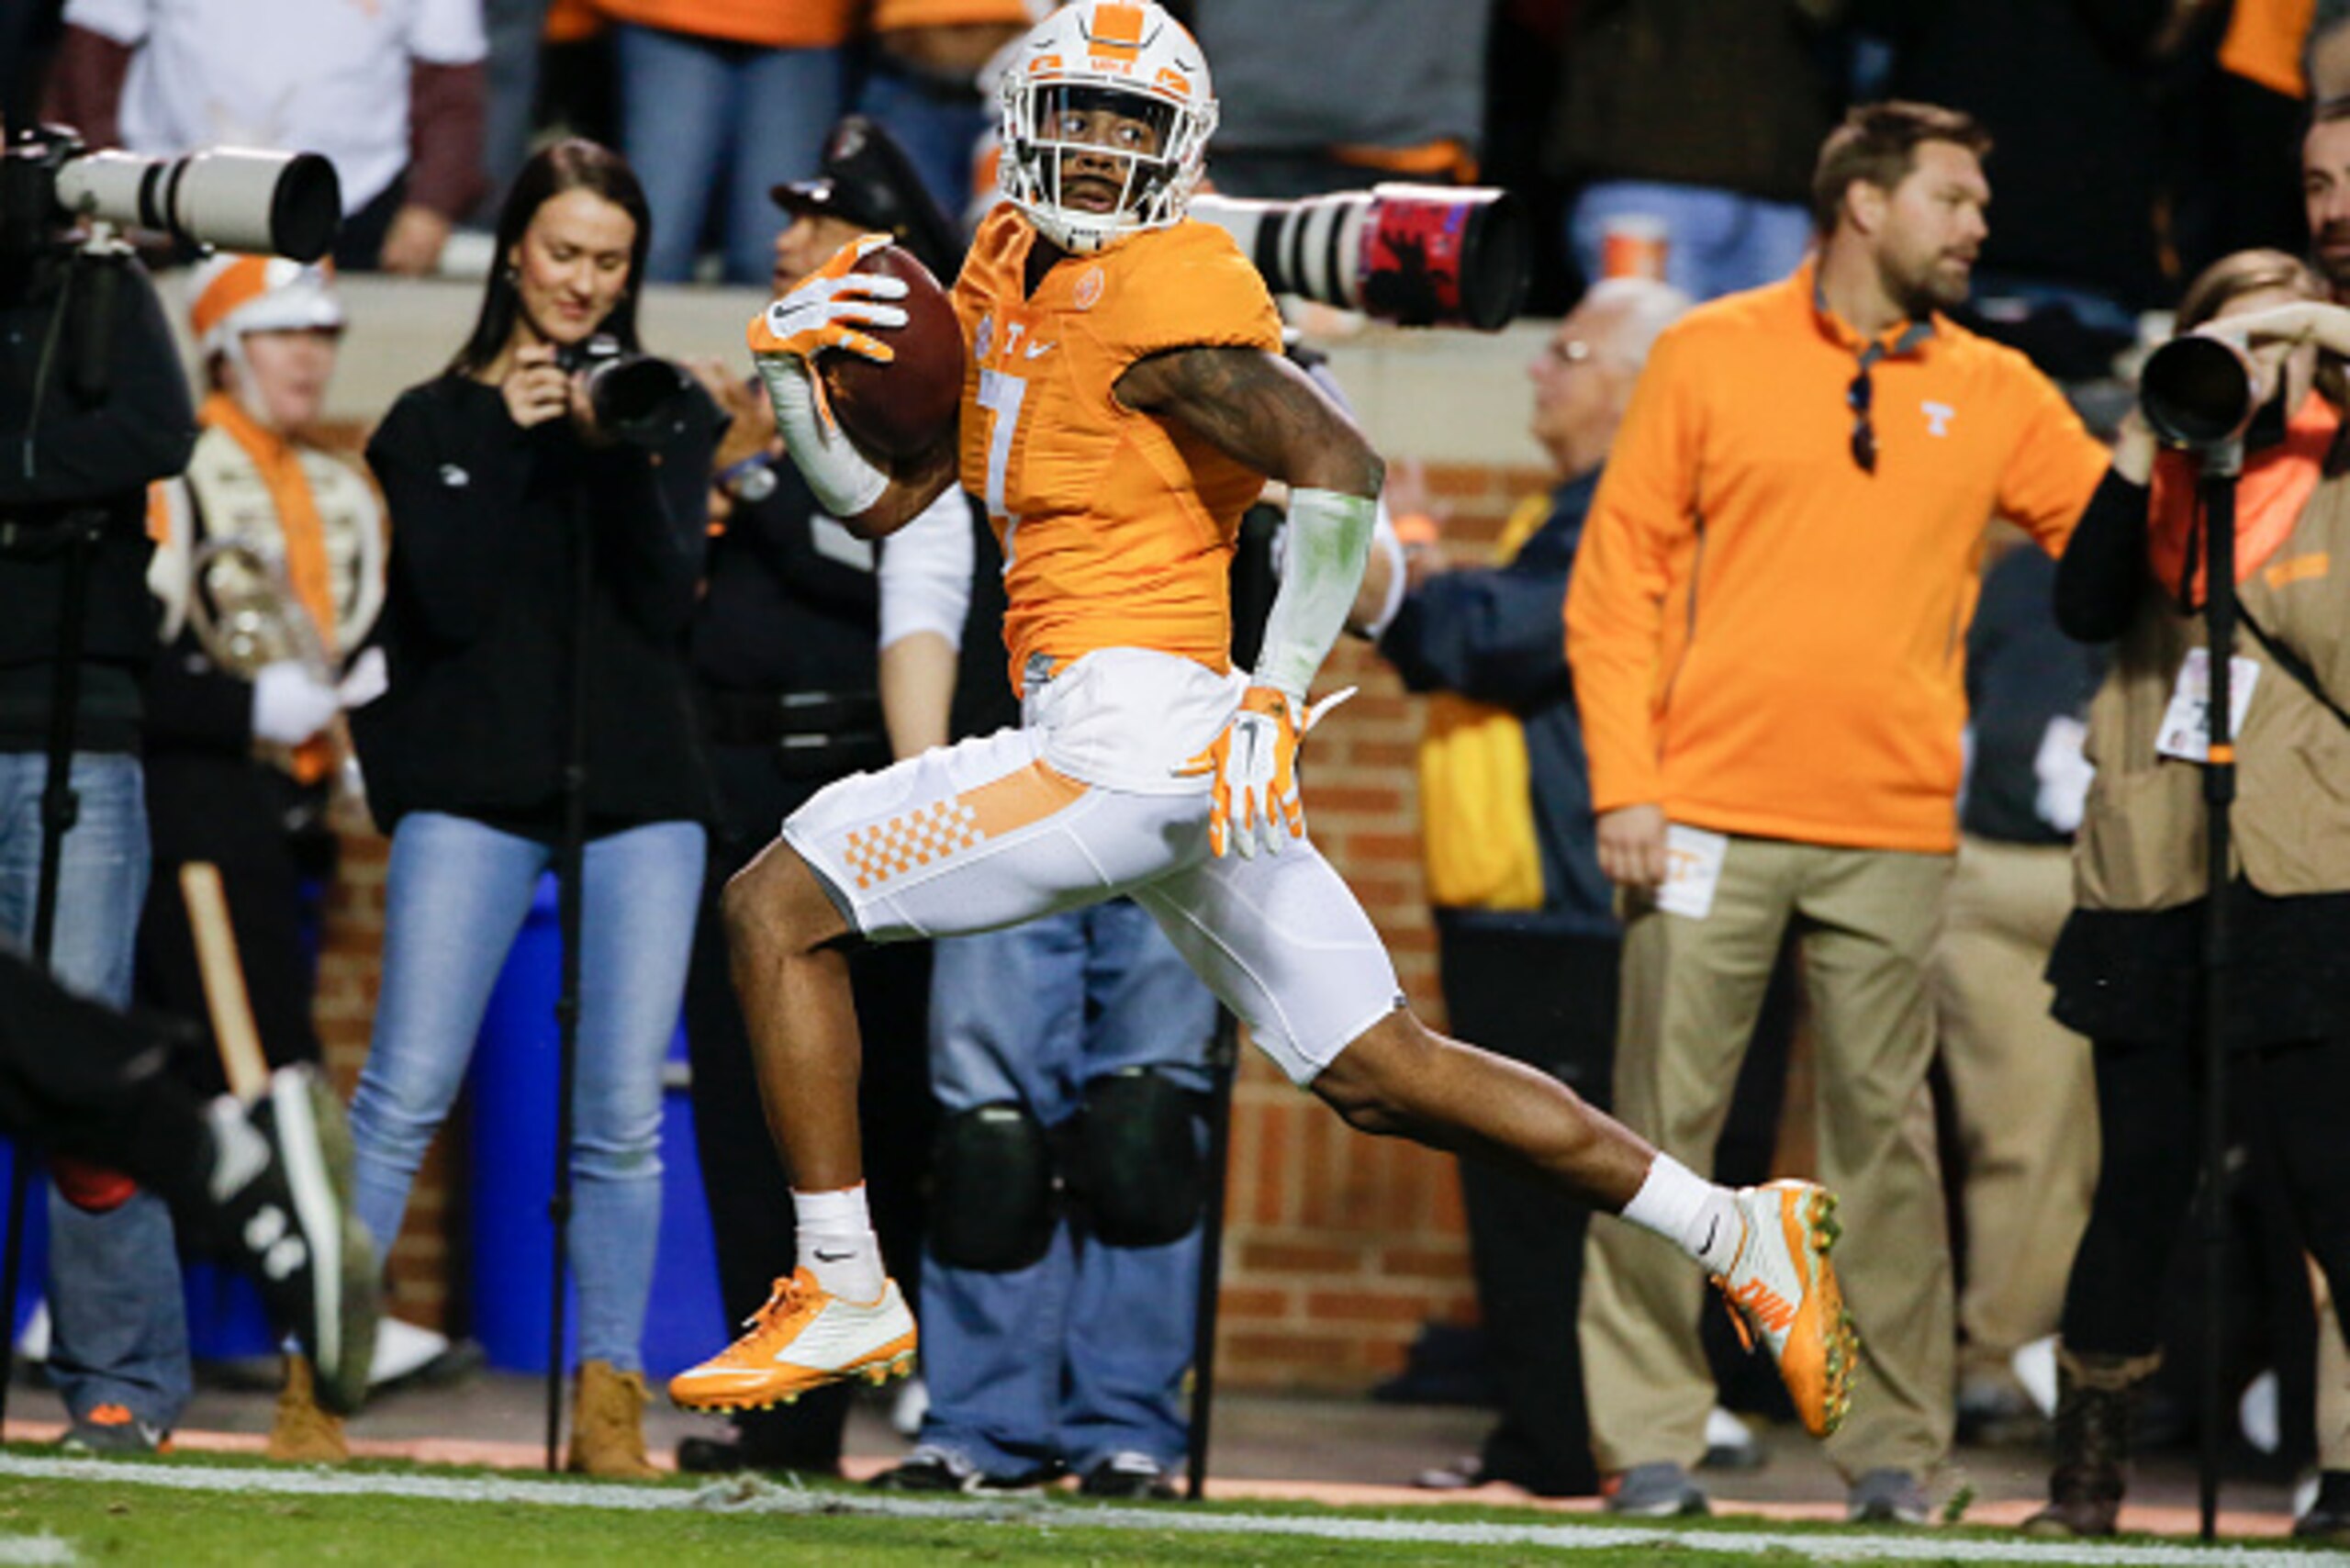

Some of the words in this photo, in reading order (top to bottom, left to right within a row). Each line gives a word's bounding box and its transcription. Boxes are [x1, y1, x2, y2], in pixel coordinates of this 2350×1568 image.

[1004, 322, 1025, 354] T
[1920, 400, 1955, 436] T
[977, 369, 1028, 576] 7
